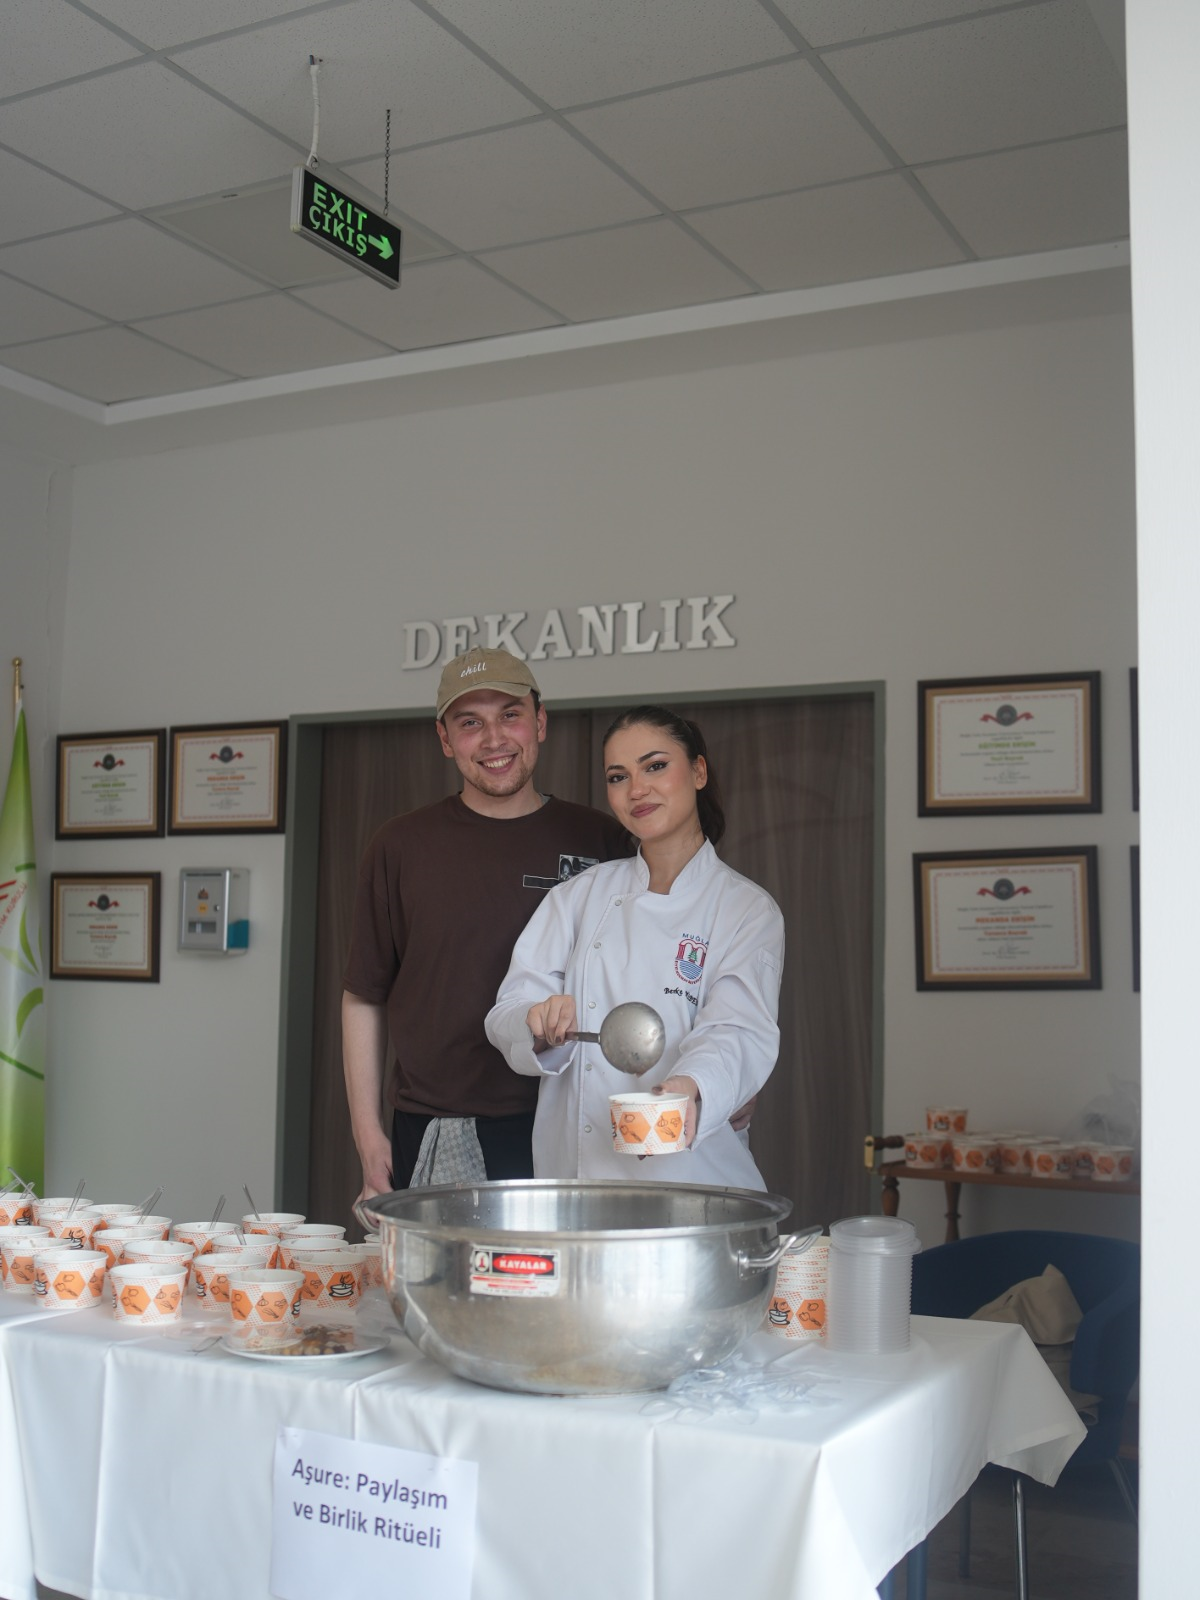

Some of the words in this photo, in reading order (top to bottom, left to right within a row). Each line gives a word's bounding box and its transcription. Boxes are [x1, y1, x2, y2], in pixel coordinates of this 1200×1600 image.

[309, 205, 367, 256] ÇIKIŞ
[313, 182, 367, 231] EXIT
[401, 594, 736, 671] DEKANLIK
[460, 661, 487, 678] chill
[499, 1259, 547, 1271] KAYALAR
[291, 1458, 350, 1490] Aşure:
[356, 1473, 448, 1510] Paylaşım
[293, 1501, 314, 1520] ve
[319, 1503, 368, 1534] Birlik
[374, 1516, 441, 1549] Ritüeli
